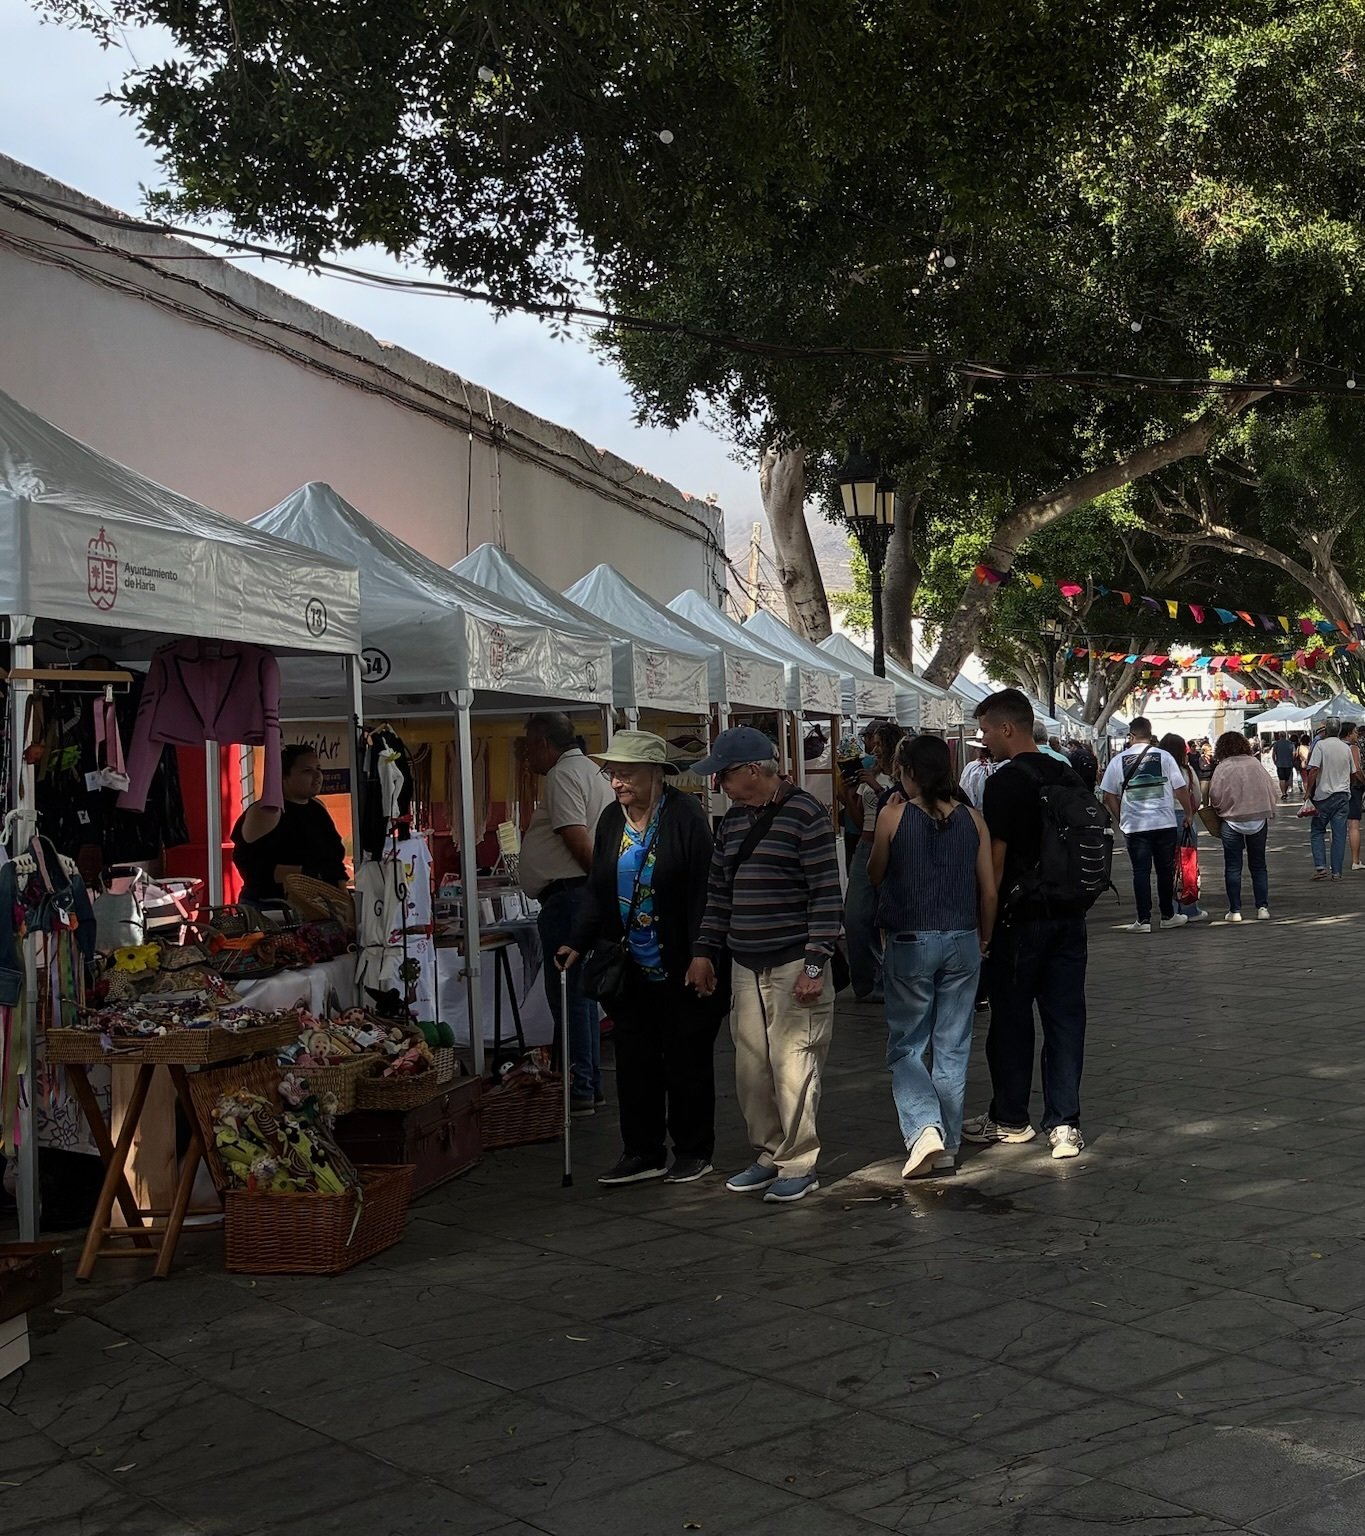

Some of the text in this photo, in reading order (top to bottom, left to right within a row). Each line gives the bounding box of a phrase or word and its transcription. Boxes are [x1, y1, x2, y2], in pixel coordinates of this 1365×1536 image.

[124, 562, 178, 581] Ayuntamiento
[124, 578, 156, 591] de Haría
